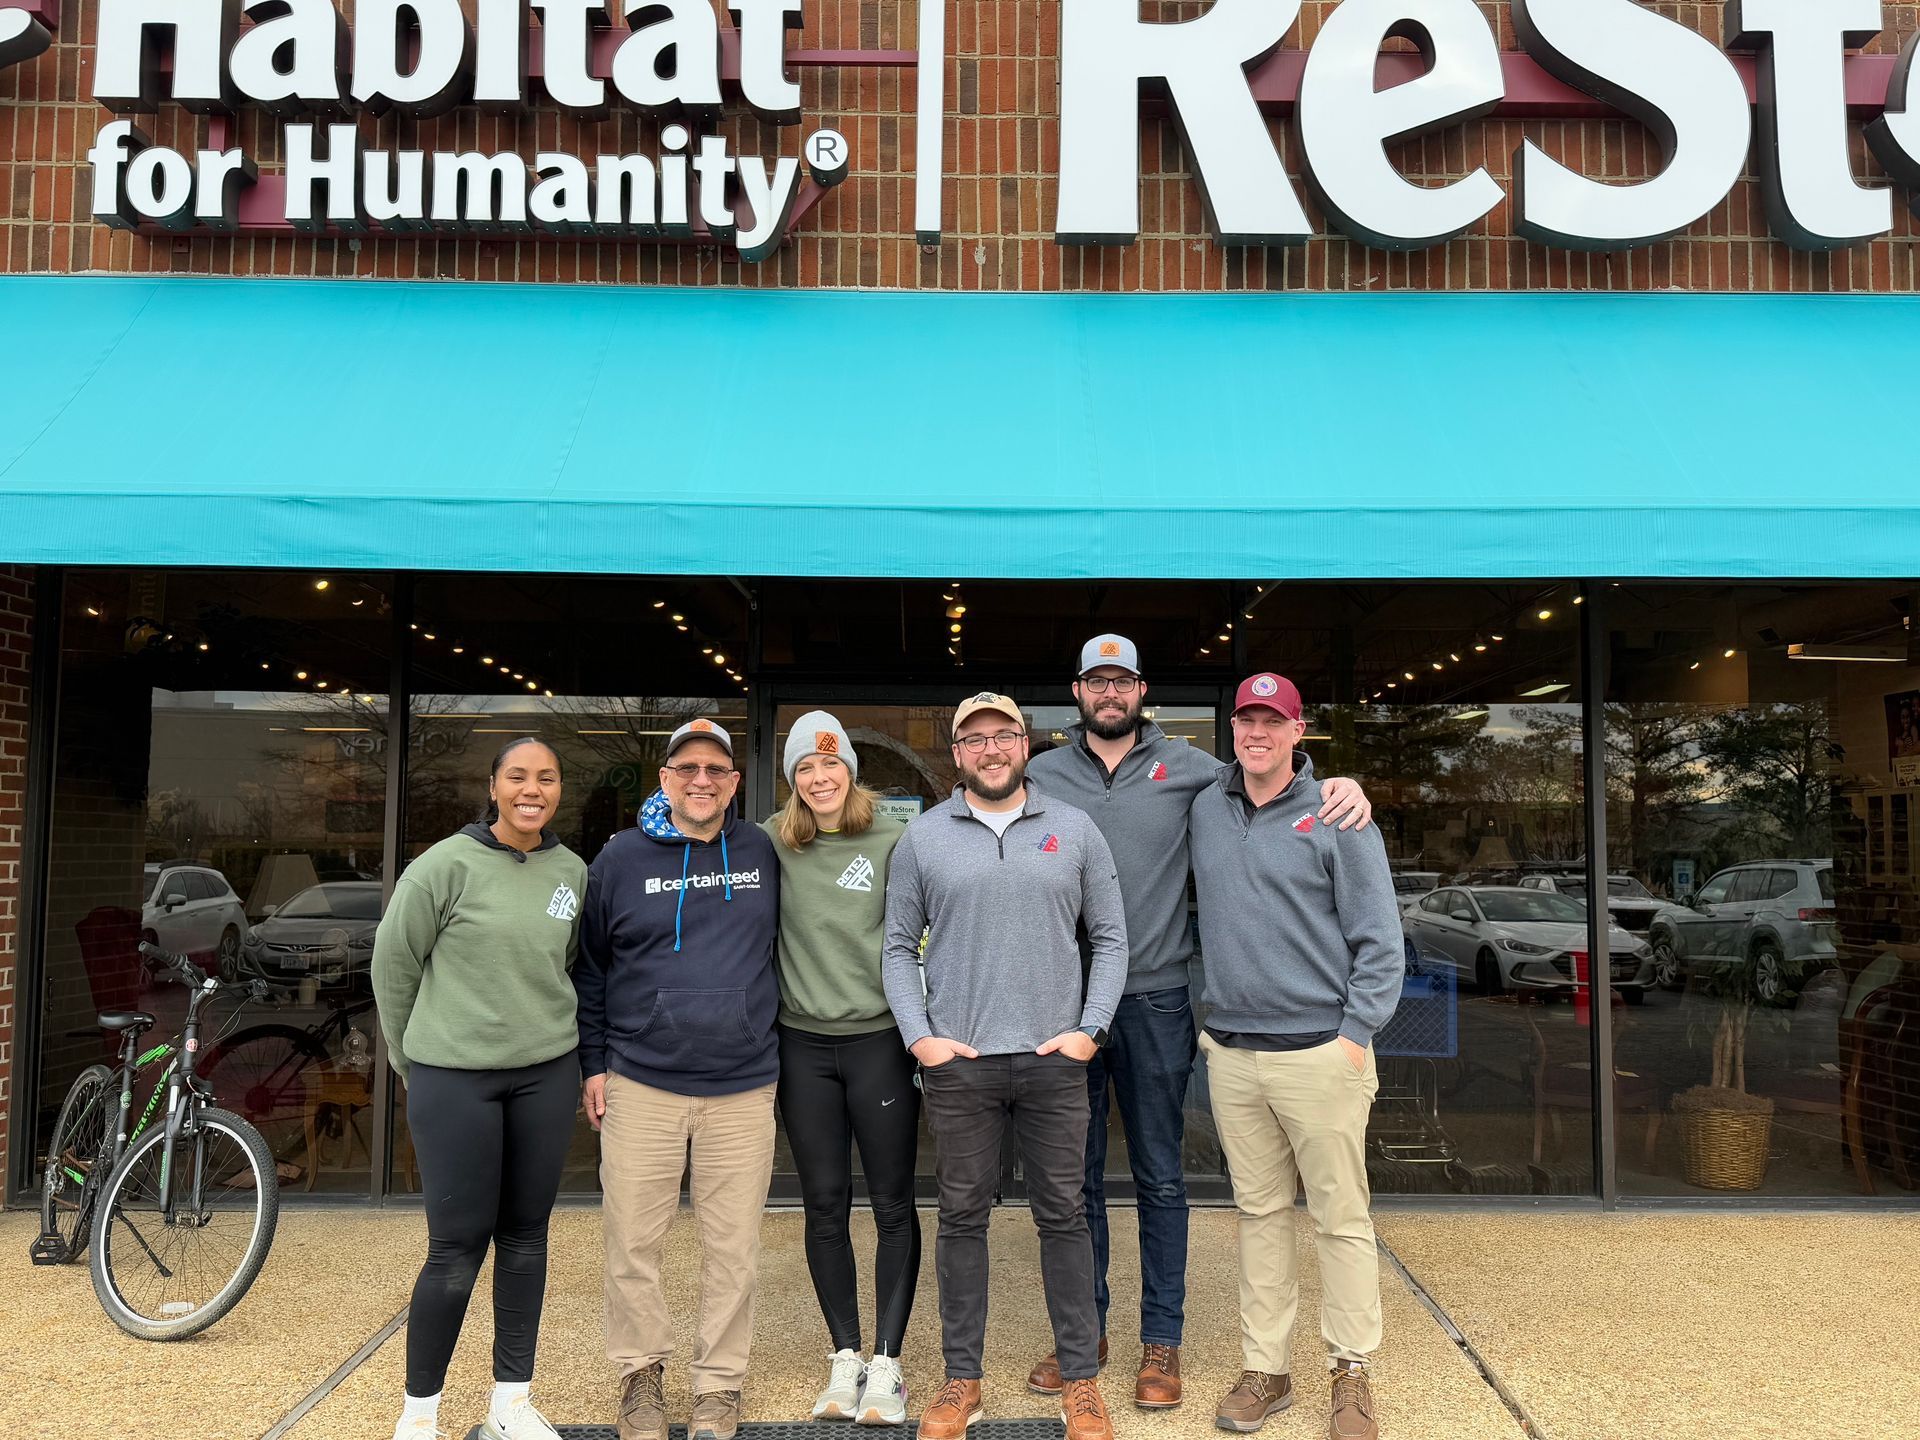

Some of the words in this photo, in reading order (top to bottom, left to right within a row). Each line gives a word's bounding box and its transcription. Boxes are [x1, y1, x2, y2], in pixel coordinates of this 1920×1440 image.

[1055, 0, 1920, 246] ReSt
[88, 120, 243, 219] for
[285, 123, 800, 250] Humanity
[891, 805, 915, 813] ReStore
[661, 868, 760, 892] certainteed
[836, 853, 867, 888] RETEX
[545, 882, 571, 918] RETEX
